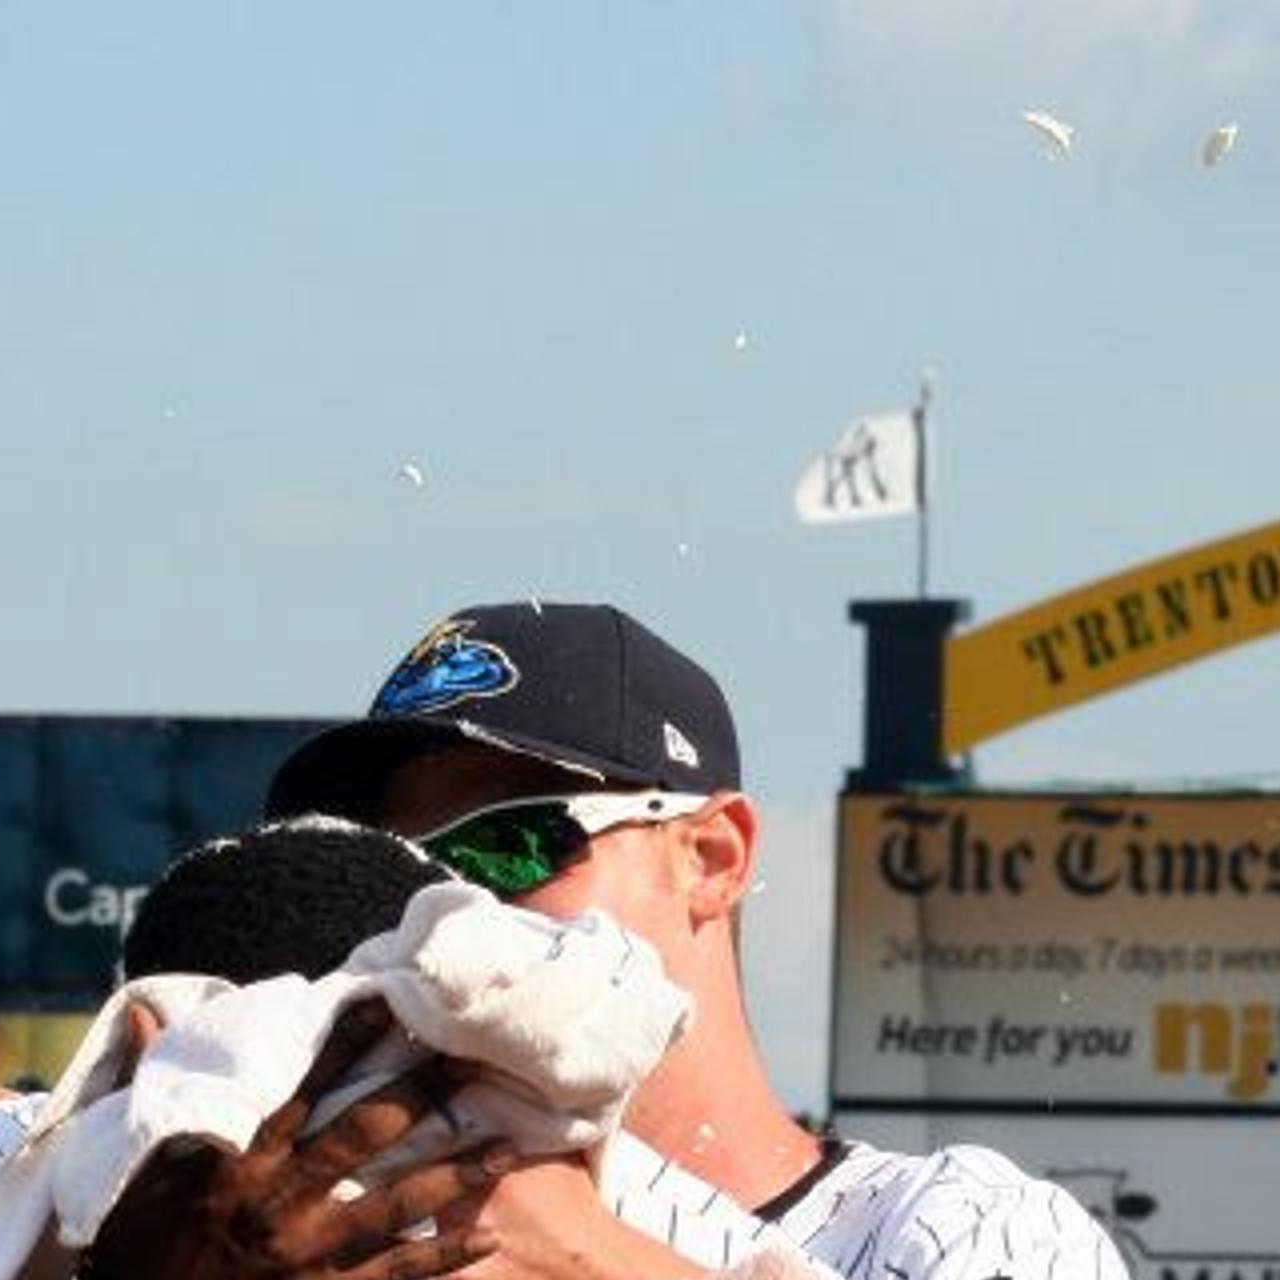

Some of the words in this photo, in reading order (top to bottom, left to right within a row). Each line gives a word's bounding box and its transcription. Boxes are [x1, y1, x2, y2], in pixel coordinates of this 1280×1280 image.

[878, 804, 1034, 897] The
[877, 1014, 977, 1054] Here
[984, 1014, 1048, 1067] for
[1050, 1026, 1132, 1067] you
